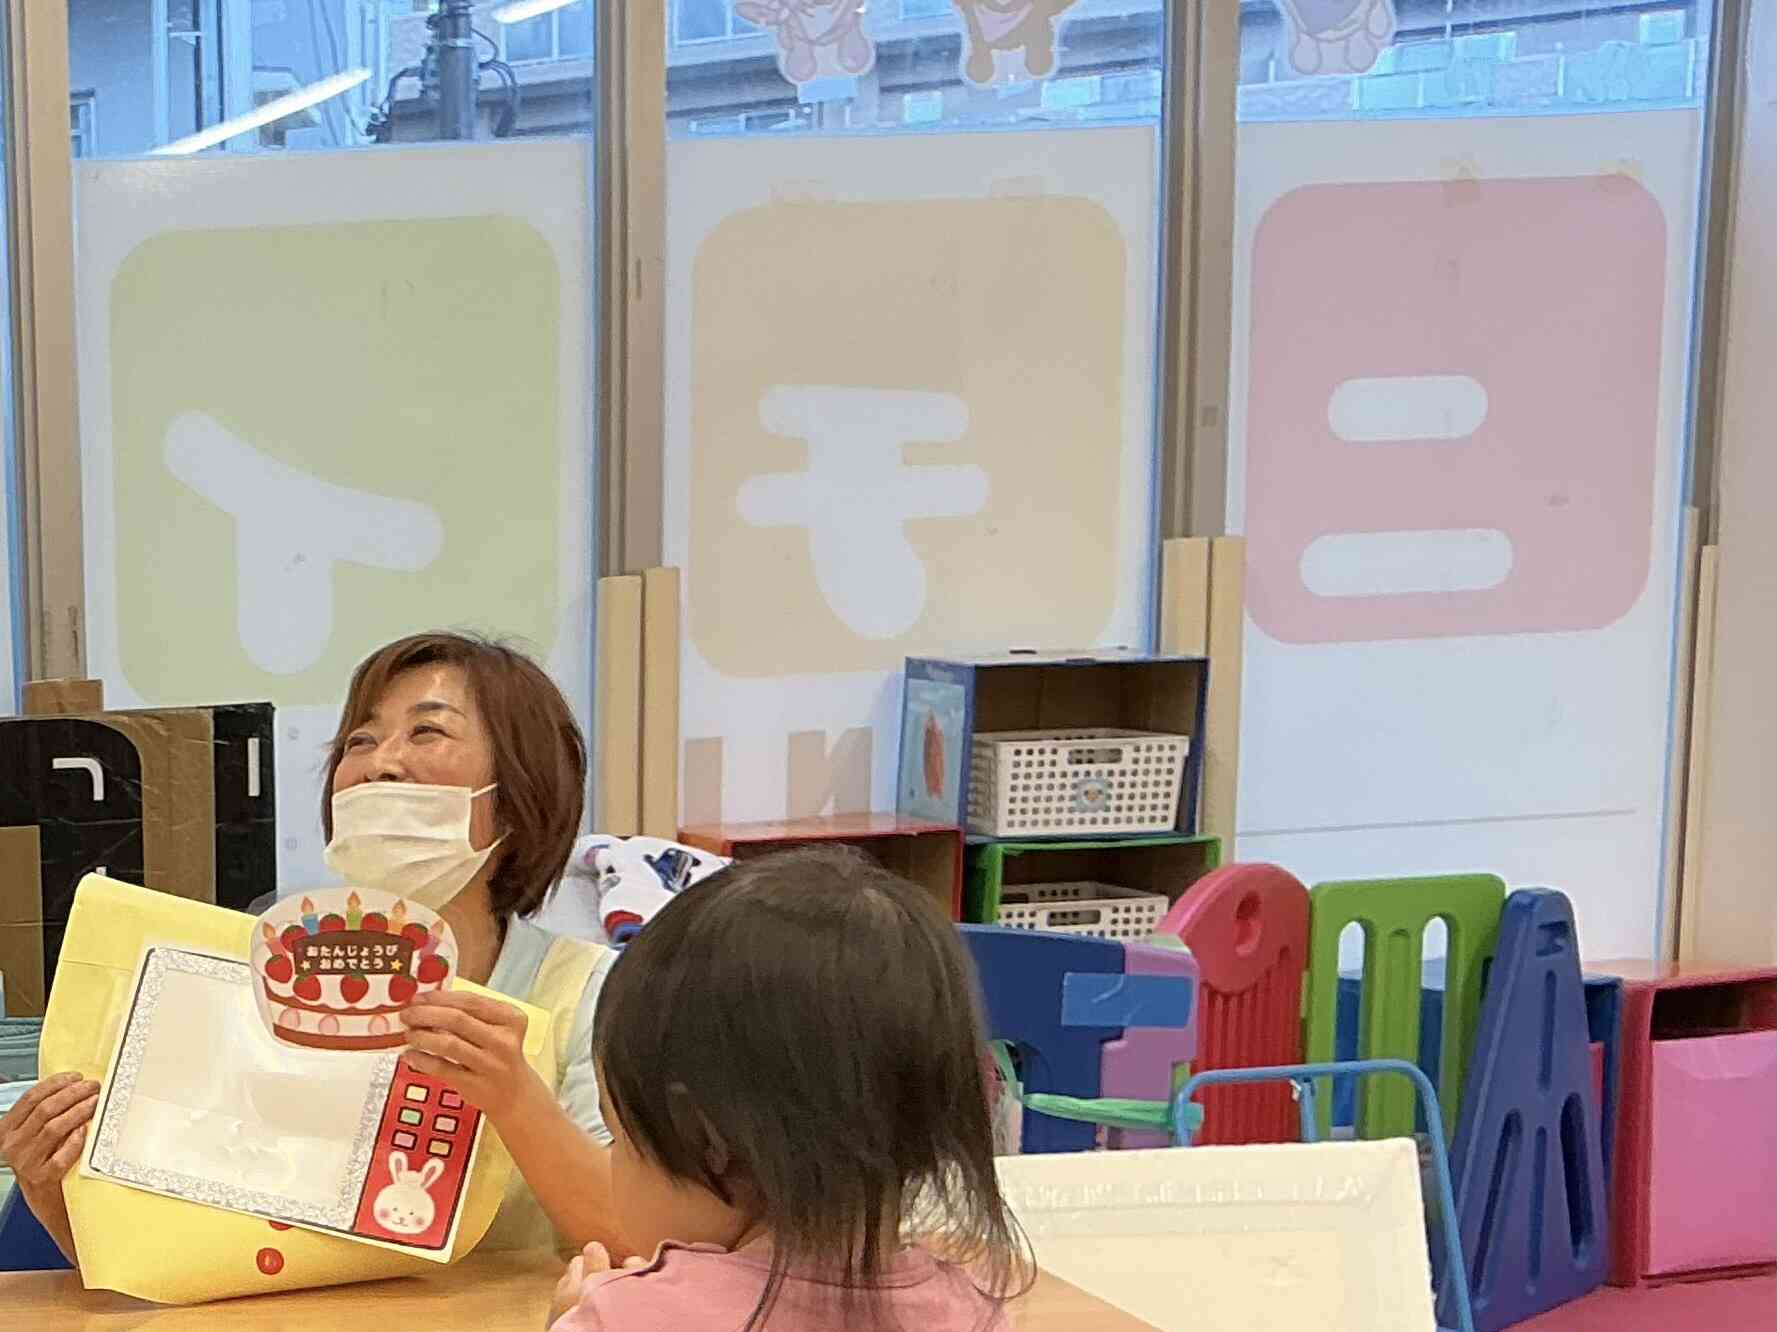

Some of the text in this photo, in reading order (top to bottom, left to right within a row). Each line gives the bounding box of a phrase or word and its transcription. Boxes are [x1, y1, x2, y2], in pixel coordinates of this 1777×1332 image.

[306, 945, 399, 957] おたんじょうび
[319, 958, 384, 970] おめでとう
